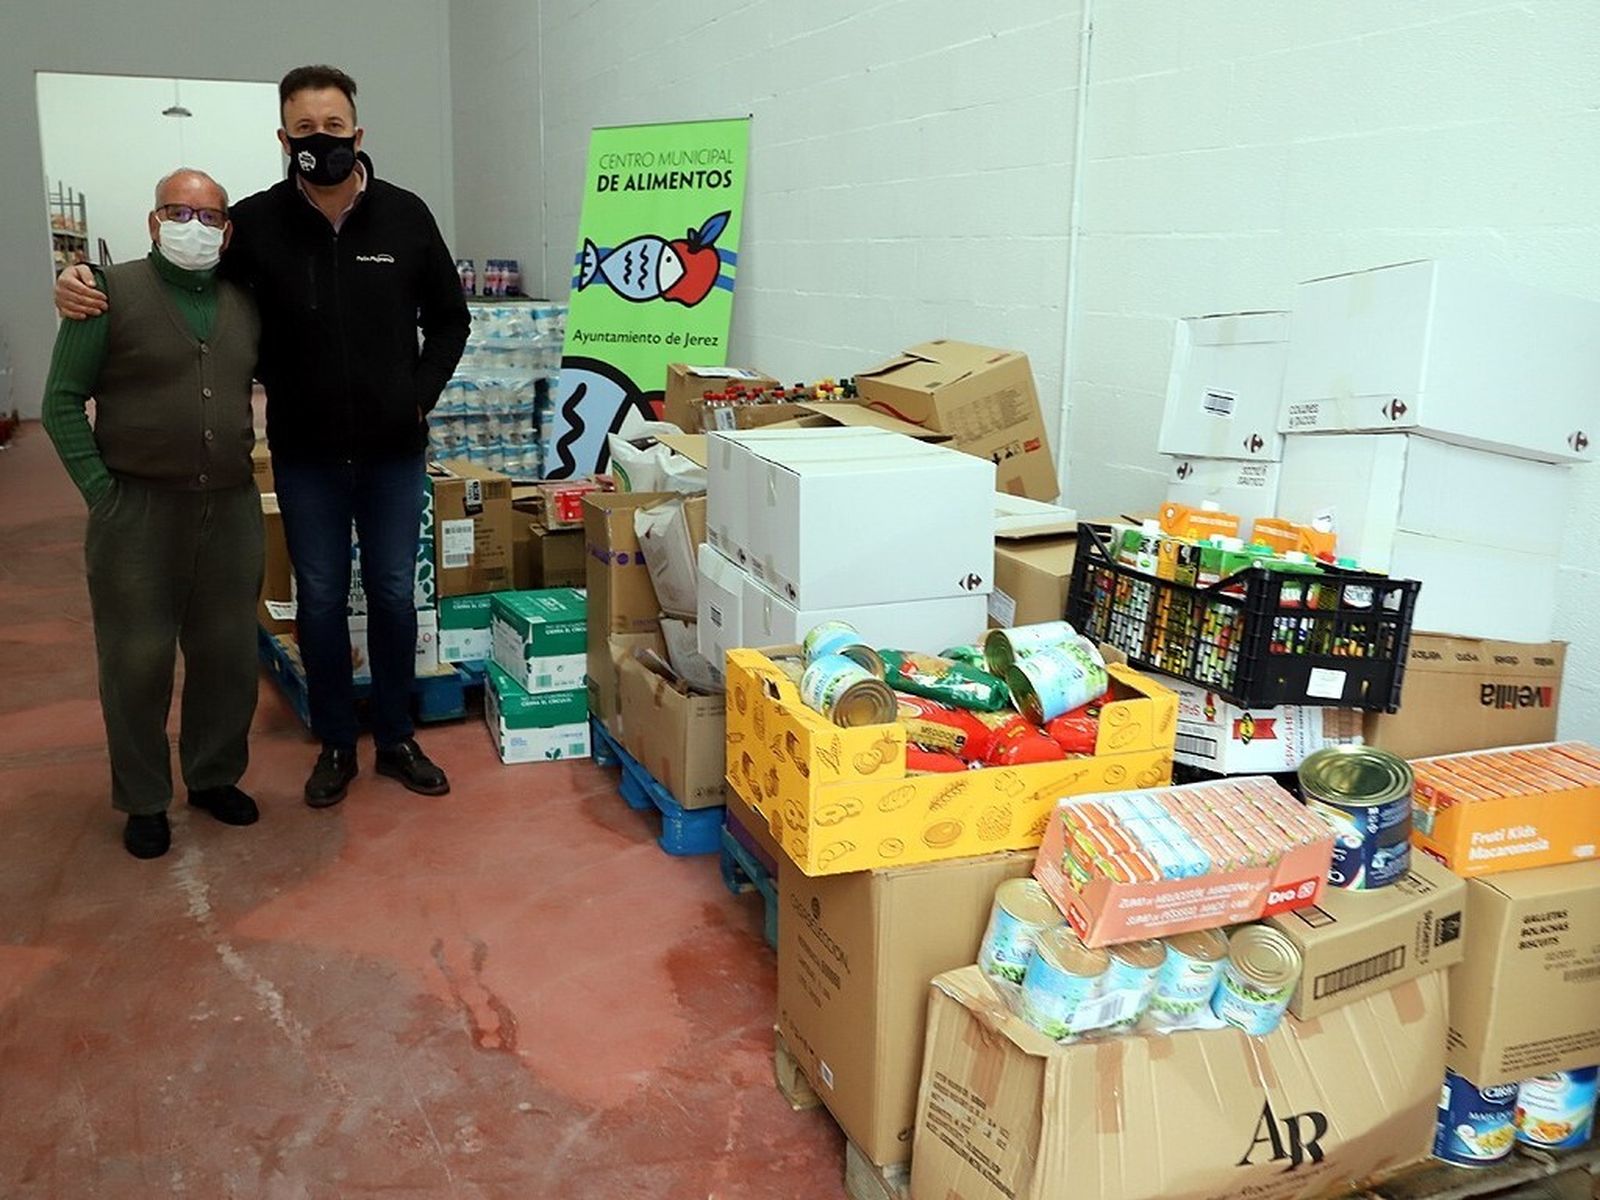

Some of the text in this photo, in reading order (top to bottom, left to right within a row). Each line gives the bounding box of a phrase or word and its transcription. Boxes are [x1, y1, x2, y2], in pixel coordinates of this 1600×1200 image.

[599, 148, 734, 170] CENTRO MUNICIPAL
[597, 169, 732, 192] DE ALIMENTOS
[572, 329, 718, 348] Ayuntamiento de Jerez
[1480, 683, 1552, 709] velilla
[1236, 1101, 1329, 1171] AR
